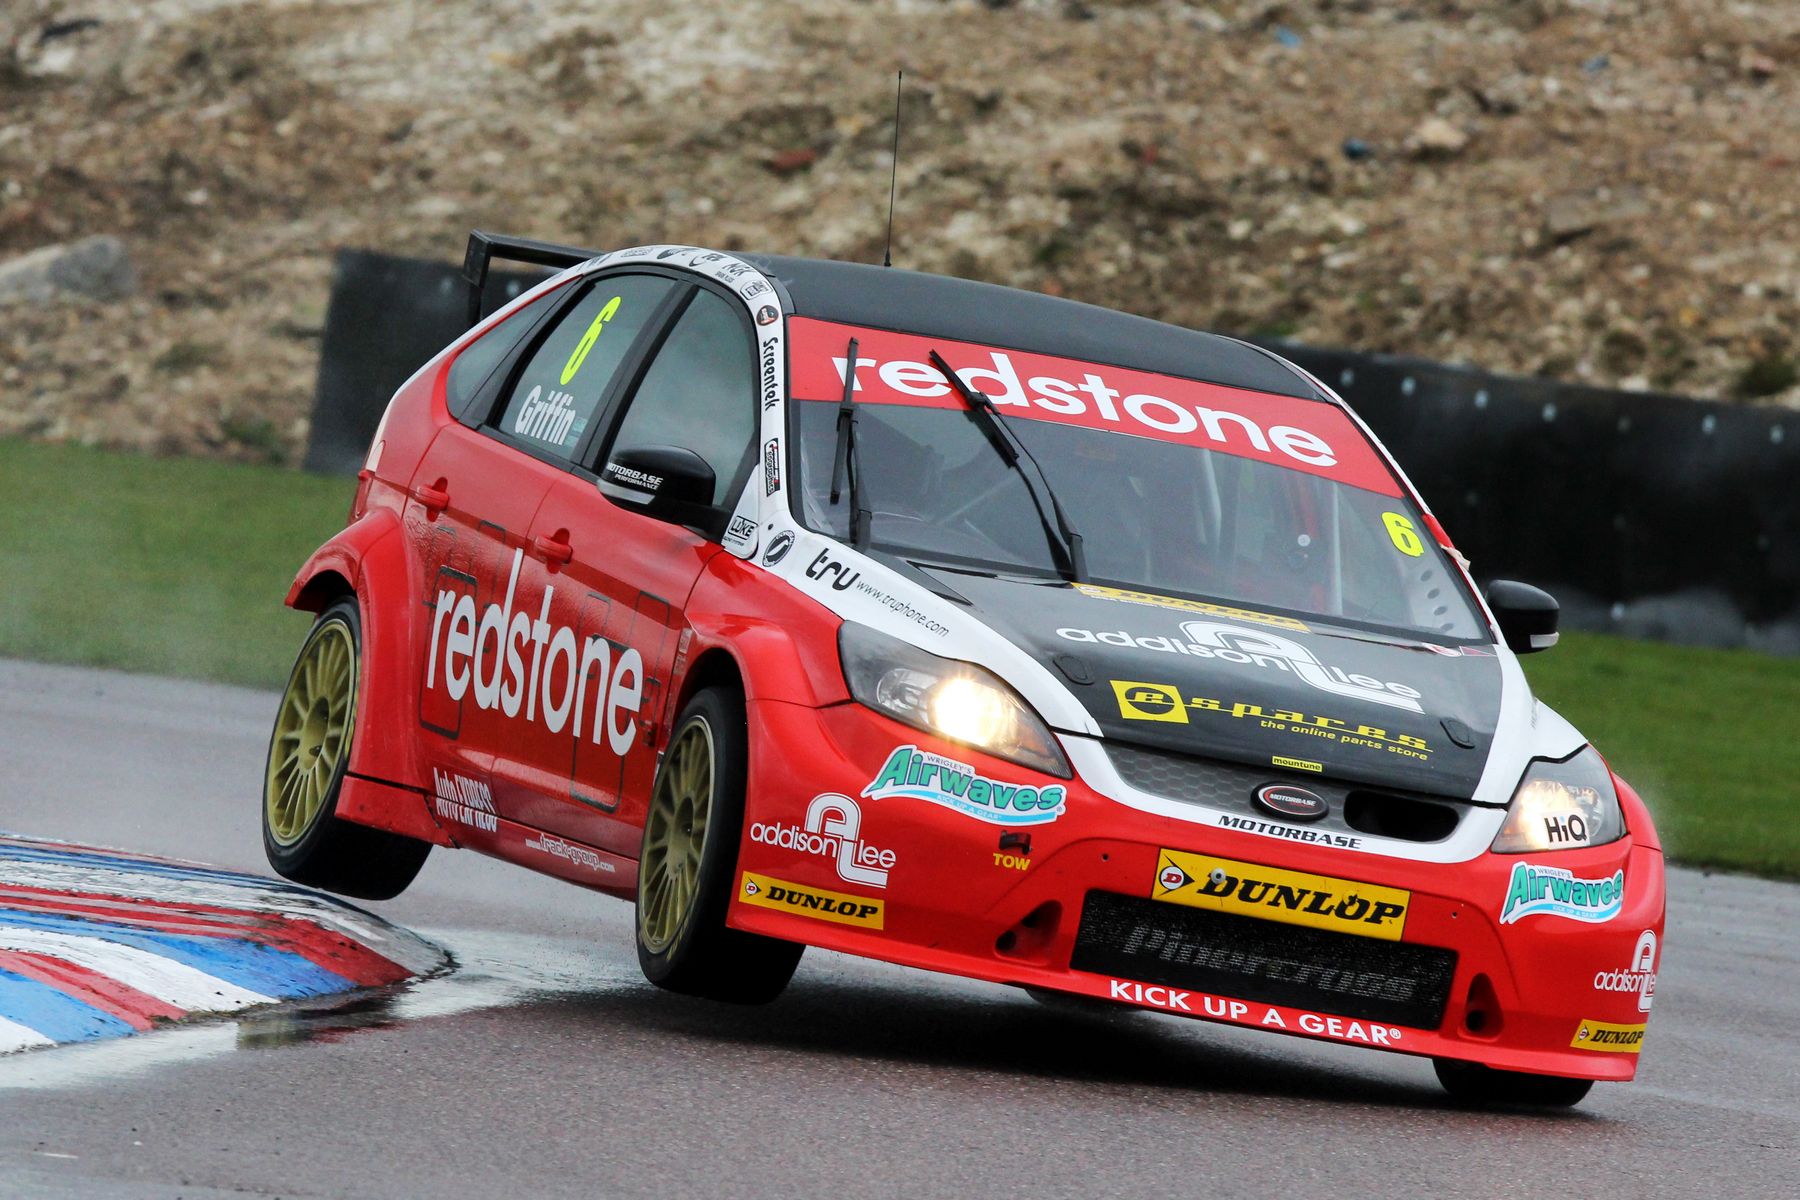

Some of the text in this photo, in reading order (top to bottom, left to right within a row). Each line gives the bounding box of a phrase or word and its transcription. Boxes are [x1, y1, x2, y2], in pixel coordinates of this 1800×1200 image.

[560, 296, 622, 385] 6
[763, 336, 780, 411] Screentek
[515, 385, 576, 445] Griffin
[831, 352, 1338, 467] redstone
[1381, 511, 1425, 557] 6
[805, 548, 860, 591] tru
[857, 580, 950, 638] www.truphone.com
[426, 548, 644, 756] redstone
[1055, 626, 1422, 700] addison lee
[1260, 719, 1429, 761] the online parts store
[866, 748, 1063, 811] Airwaves
[927, 755, 972, 775] WRIGLEY'S
[1273, 757, 1322, 771] mountune
[750, 822, 897, 869] addison lee
[1218, 815, 1363, 850] MOTORBASE
[1544, 814, 1588, 843] HiQ
[993, 853, 1031, 871] TOW
[765, 885, 878, 919] DUNLOP
[1196, 871, 1405, 925] DUNLOP
[1503, 864, 1623, 918] Airwaves
[1110, 979, 1192, 1012] KICK
[1203, 996, 1249, 1020] UP
[1261, 1007, 1286, 1028] A
[1594, 967, 1644, 993] addison
[1590, 1029, 1644, 1045] DUNLOP
